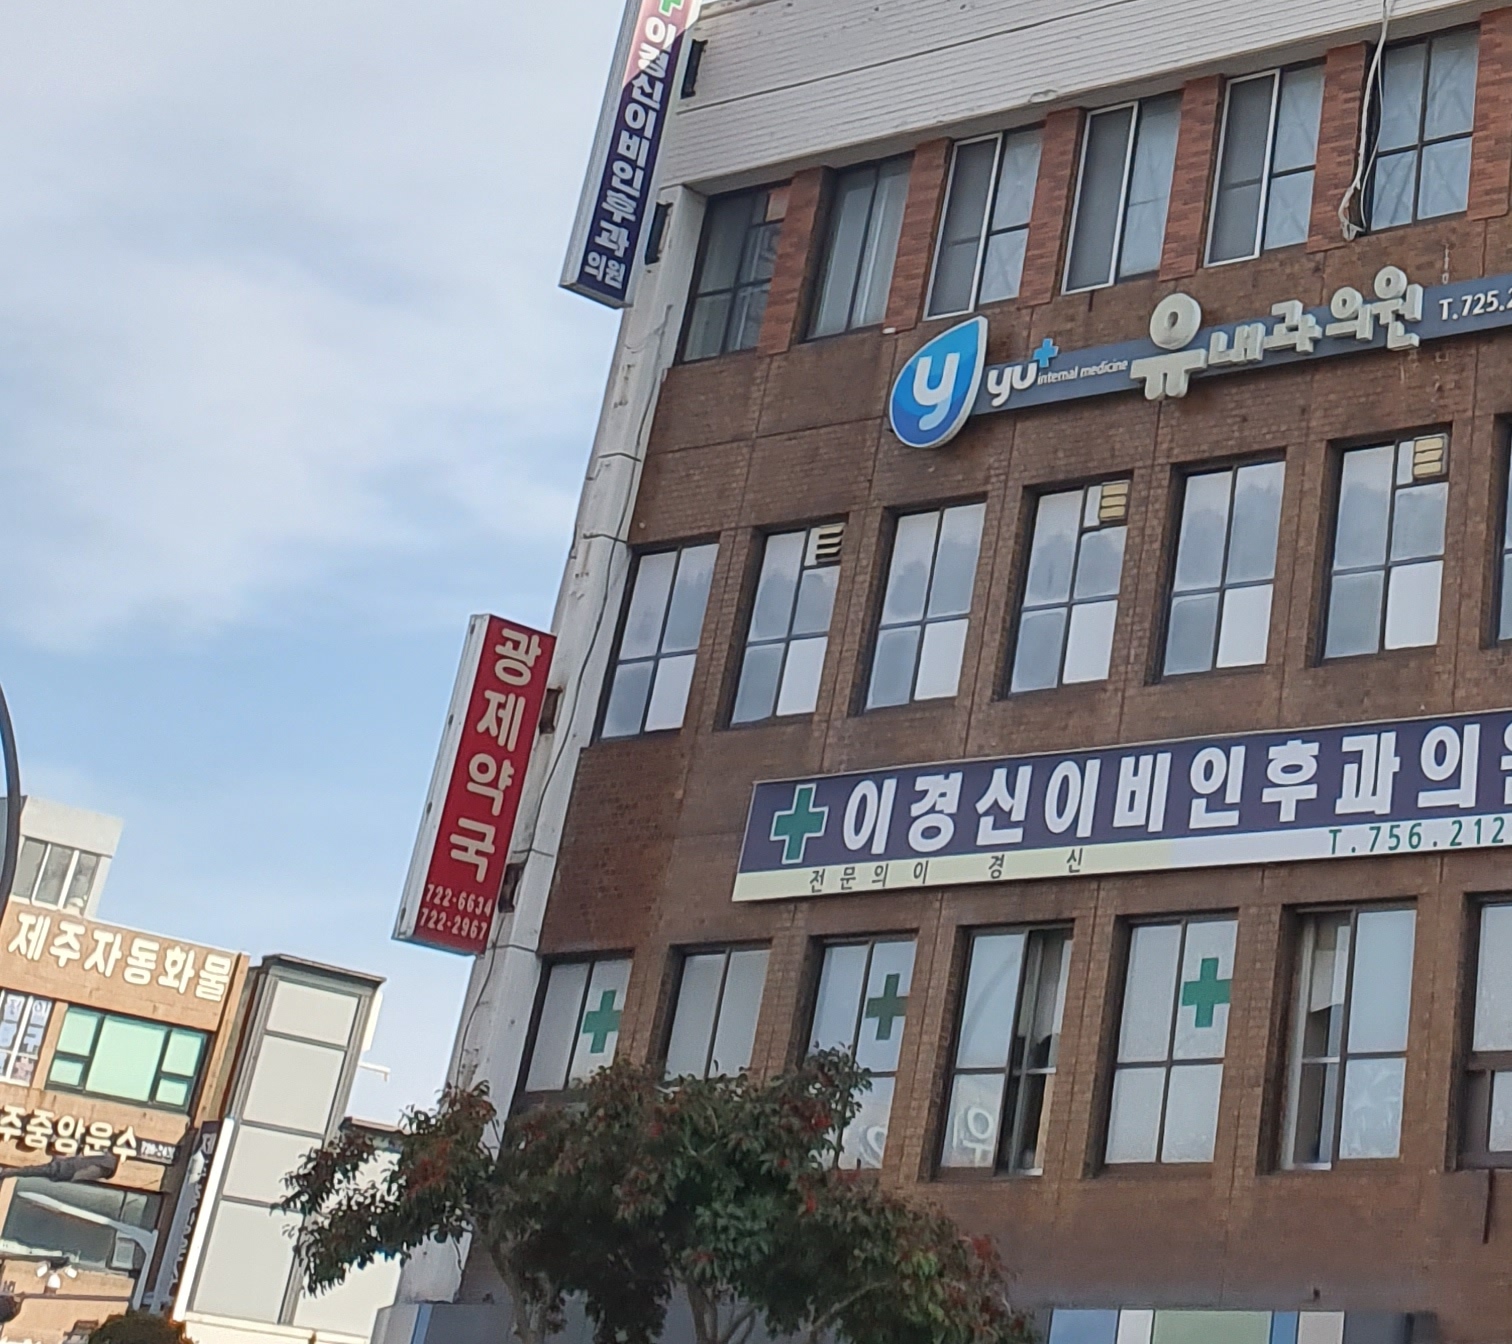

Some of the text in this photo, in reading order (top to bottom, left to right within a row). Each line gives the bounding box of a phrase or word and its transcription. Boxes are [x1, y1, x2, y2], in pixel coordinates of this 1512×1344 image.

[1037, 365, 1079, 385] internal
[1079, 359, 1129, 379] medicine
[449, 627, 542, 884] 광제약국
[8, 912, 233, 1002] 제주자동화물
